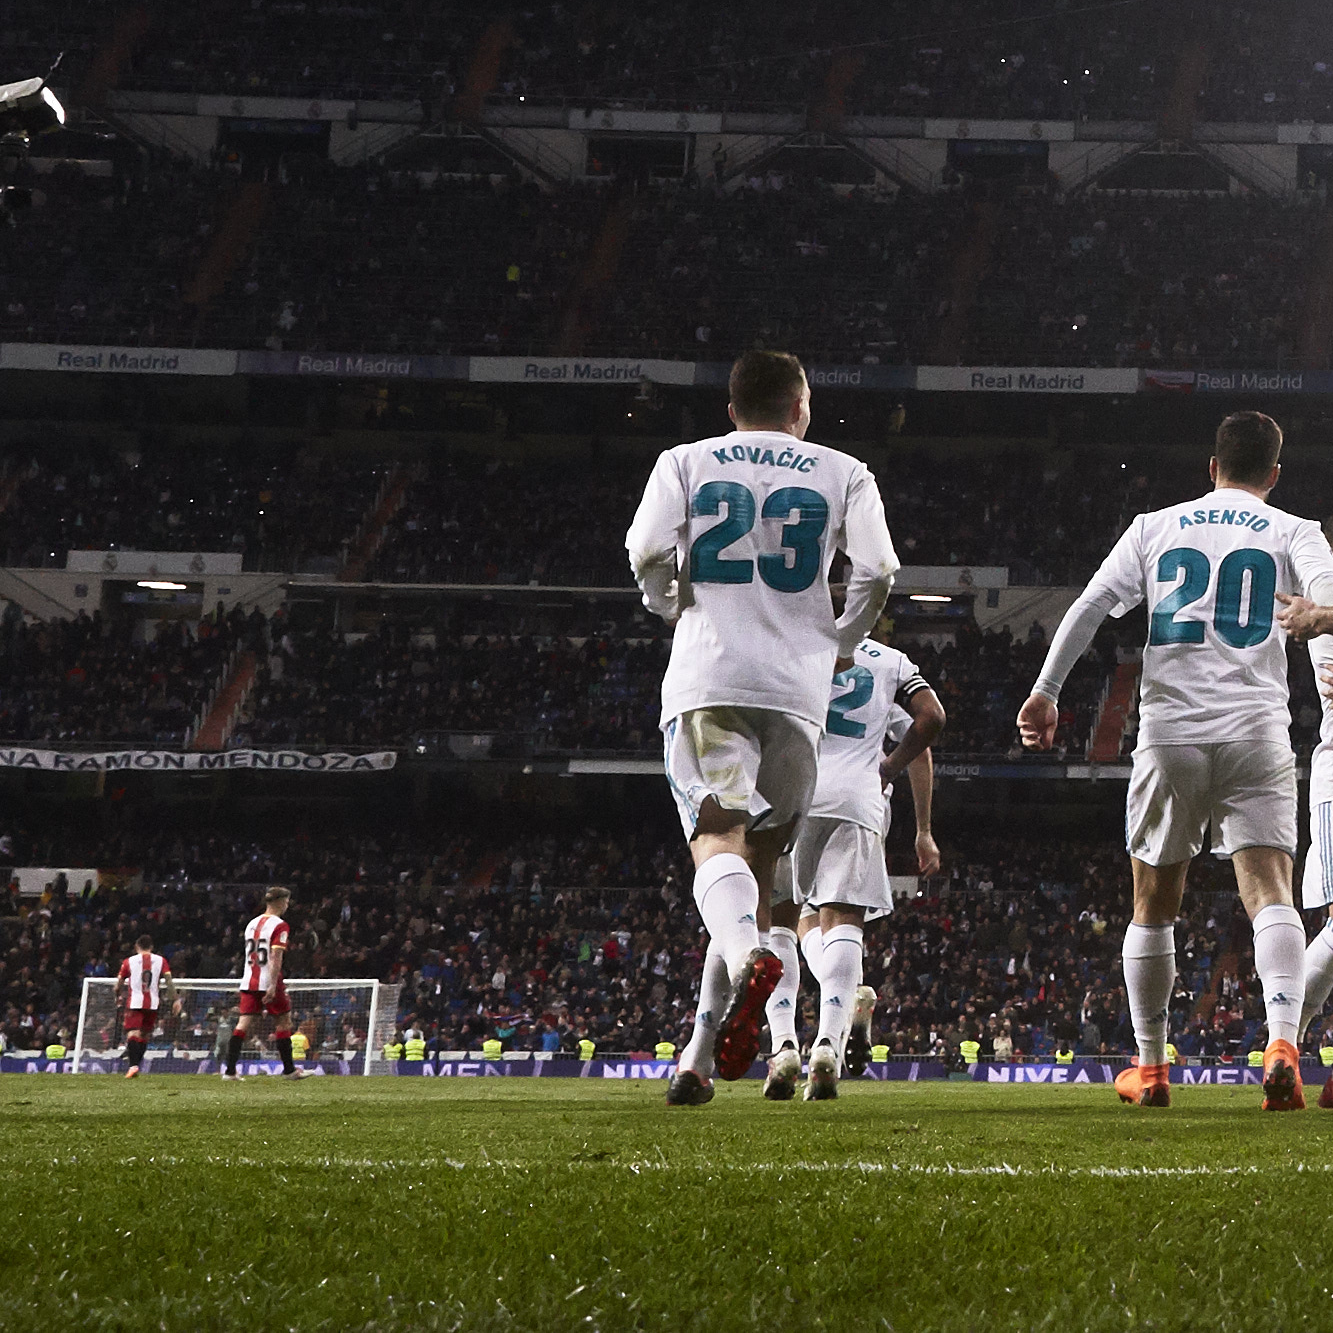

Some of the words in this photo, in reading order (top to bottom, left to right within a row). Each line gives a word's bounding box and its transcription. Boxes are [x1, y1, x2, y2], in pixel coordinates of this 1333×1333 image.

[57, 351, 103, 368] Real
[108, 353, 180, 370] Madrid
[299, 354, 339, 372] Real
[345, 357, 411, 375] Madrid
[524, 363, 567, 380] Real
[573, 363, 641, 380] Madrid
[971, 372, 1011, 389] Real
[1018, 373, 1085, 390] Madrid
[1197, 372, 1235, 390] Real
[1240, 372, 1303, 390] Madrid
[713, 444, 818, 473] KOVAČIĆ
[1179, 509, 1270, 533] ASENSIO
[690, 480, 828, 593] 23
[1149, 547, 1277, 649] 20
[826, 664, 875, 740] 2
[53, 749, 187, 770] RAMÓN
[199, 752, 374, 771] MENDOZA
[422, 1063, 512, 1077] MEN
[987, 1066, 1092, 1084] NIVEA
